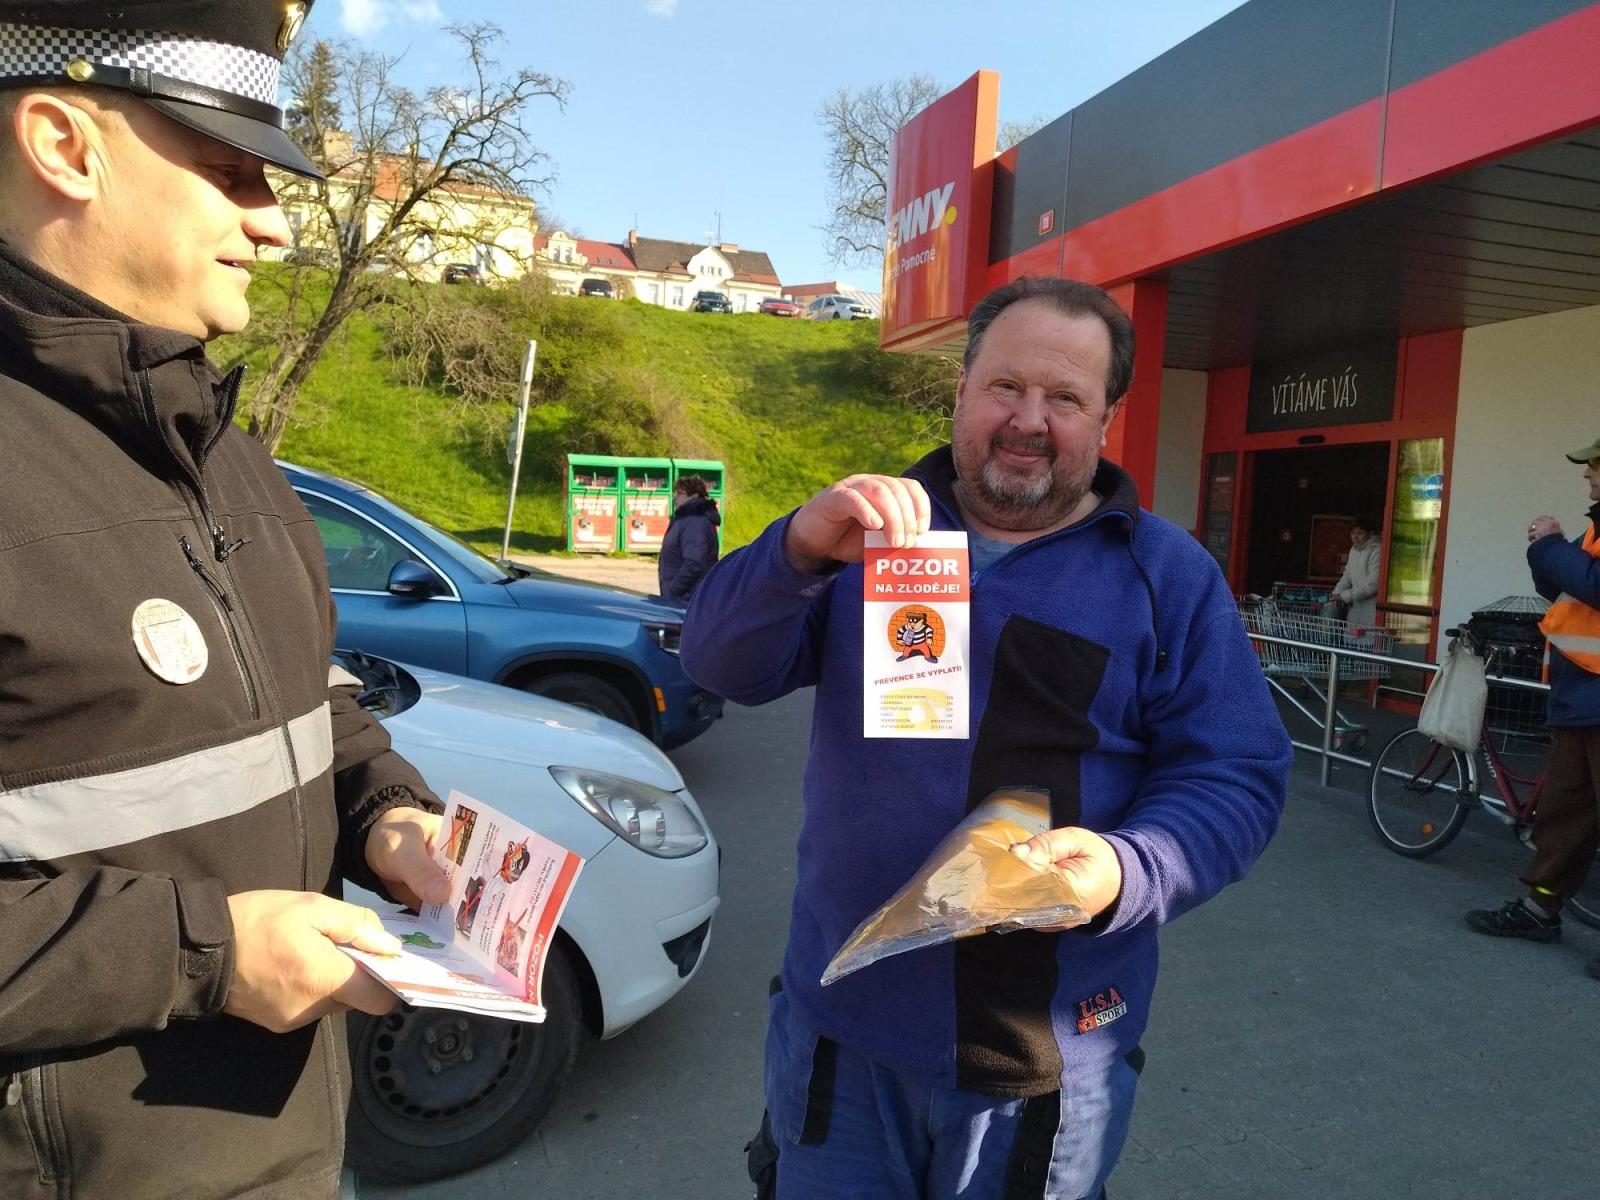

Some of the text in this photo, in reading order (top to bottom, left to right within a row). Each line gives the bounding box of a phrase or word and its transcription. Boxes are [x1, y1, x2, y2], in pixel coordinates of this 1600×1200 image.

[1272, 365, 1358, 415] VÍTÁME VÁS
[876, 558, 959, 576] POZOR
[875, 581, 960, 594] NA ZLODĚJE!
[874, 673, 915, 686] PREVENCE
[916, 671, 926, 679] SE
[528, 932, 544, 986] POZOR
[1096, 1003, 1126, 1024] SPORT
